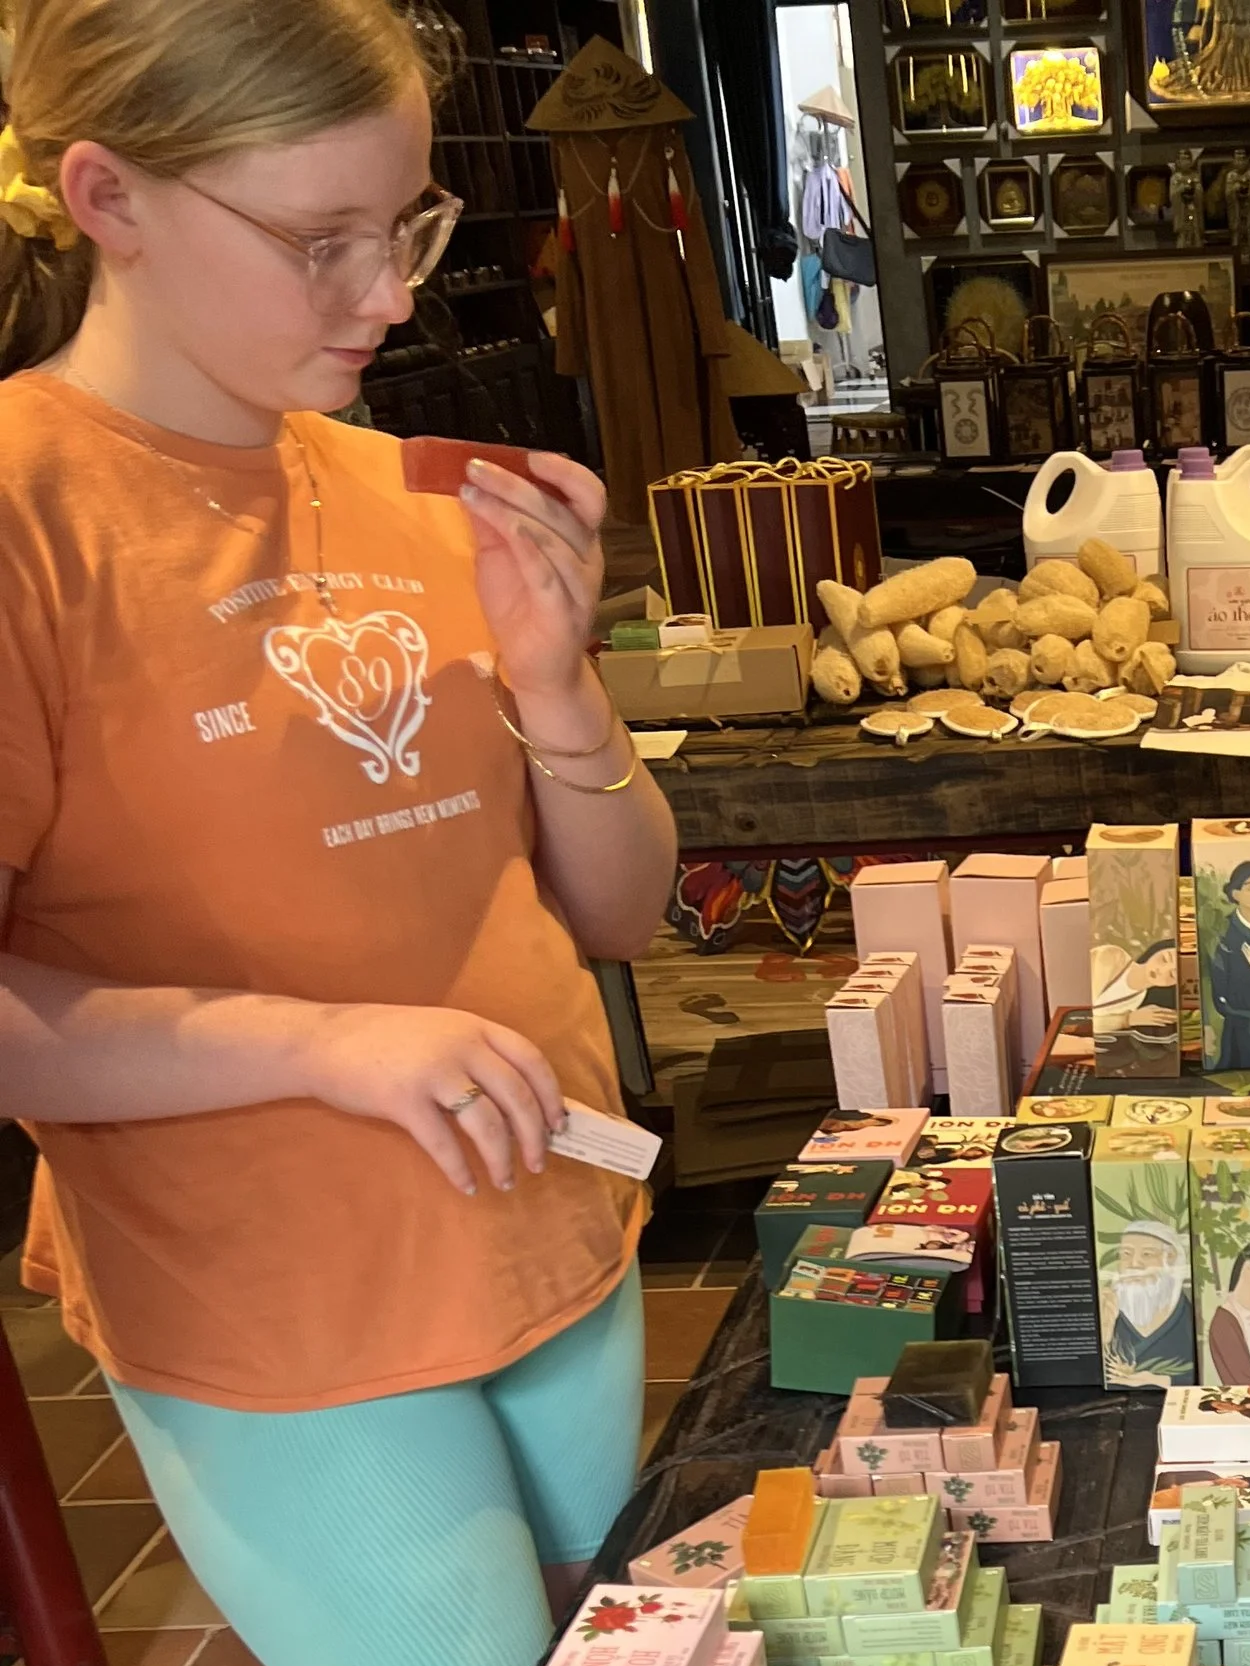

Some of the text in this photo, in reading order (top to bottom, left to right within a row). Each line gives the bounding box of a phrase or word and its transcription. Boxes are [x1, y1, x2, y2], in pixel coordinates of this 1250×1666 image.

[372, 573, 424, 594] CLUB
[338, 655, 392, 721] 89
[193, 701, 256, 743] SINCE
